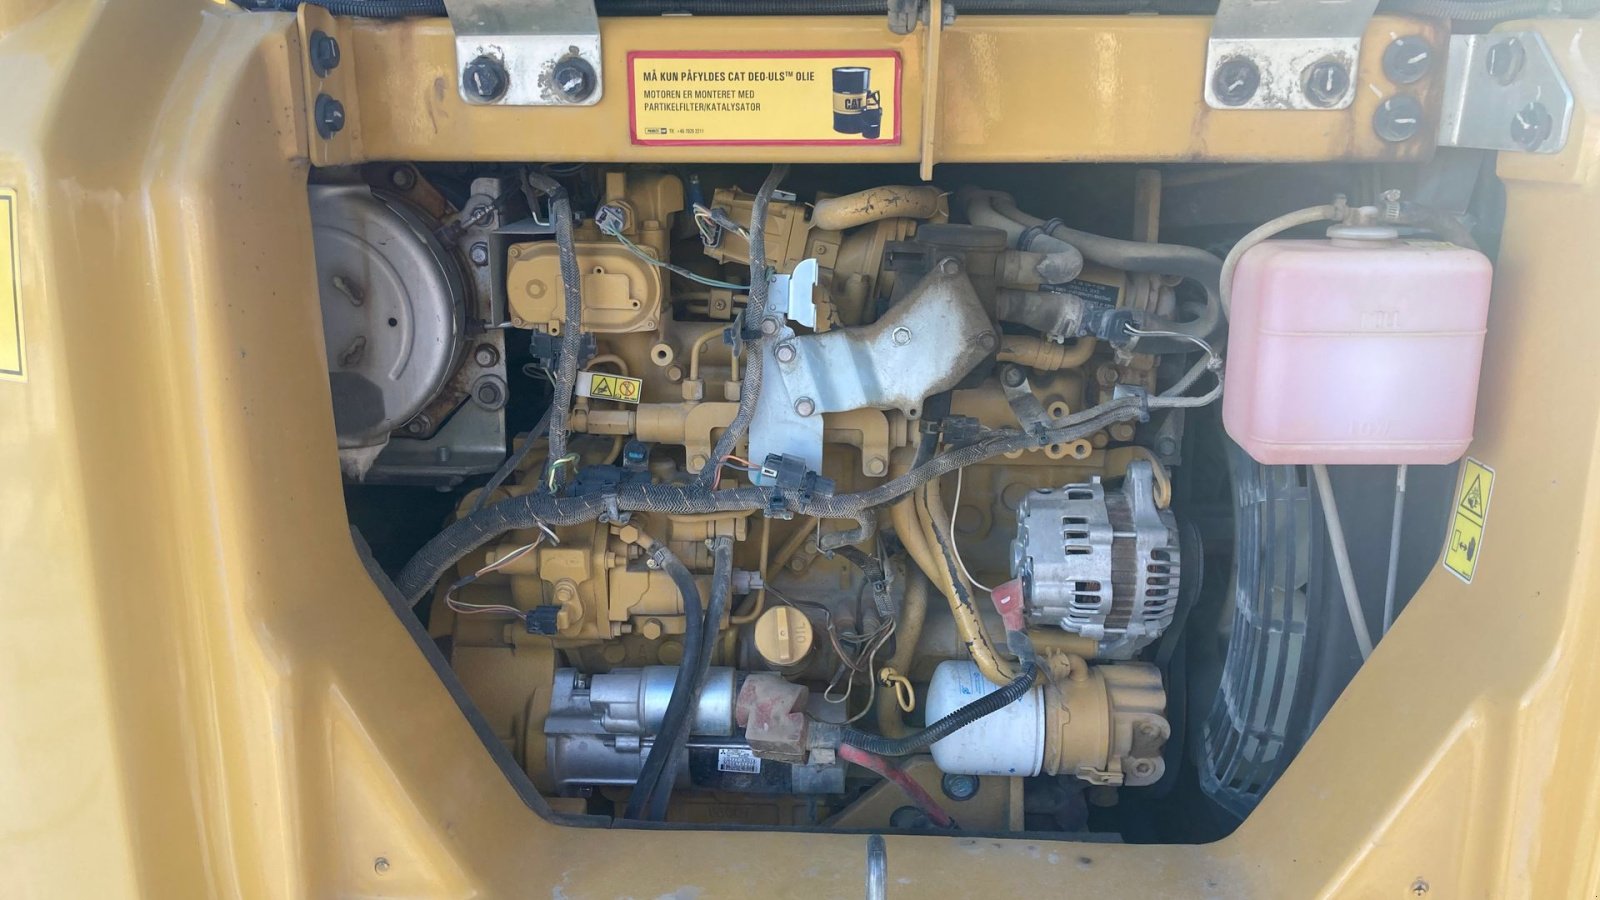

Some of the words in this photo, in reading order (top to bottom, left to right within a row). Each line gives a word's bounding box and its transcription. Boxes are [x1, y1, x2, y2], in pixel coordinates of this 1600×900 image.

[643, 69, 658, 82] MÅ
[660, 71, 679, 82] KUN
[681, 69, 726, 82] PÅFYLDES
[728, 71, 746, 82] CAT
[796, 71, 815, 82] OLIE
[643, 90, 681, 99] MOTOREN
[682, 90, 693, 99] ER
[694, 90, 736, 99] MONTERET
[738, 90, 755, 99] MED
[644, 102, 761, 112] PARTIKELFILTER/KATALYSATOR
[844, 98, 863, 110] CAT
